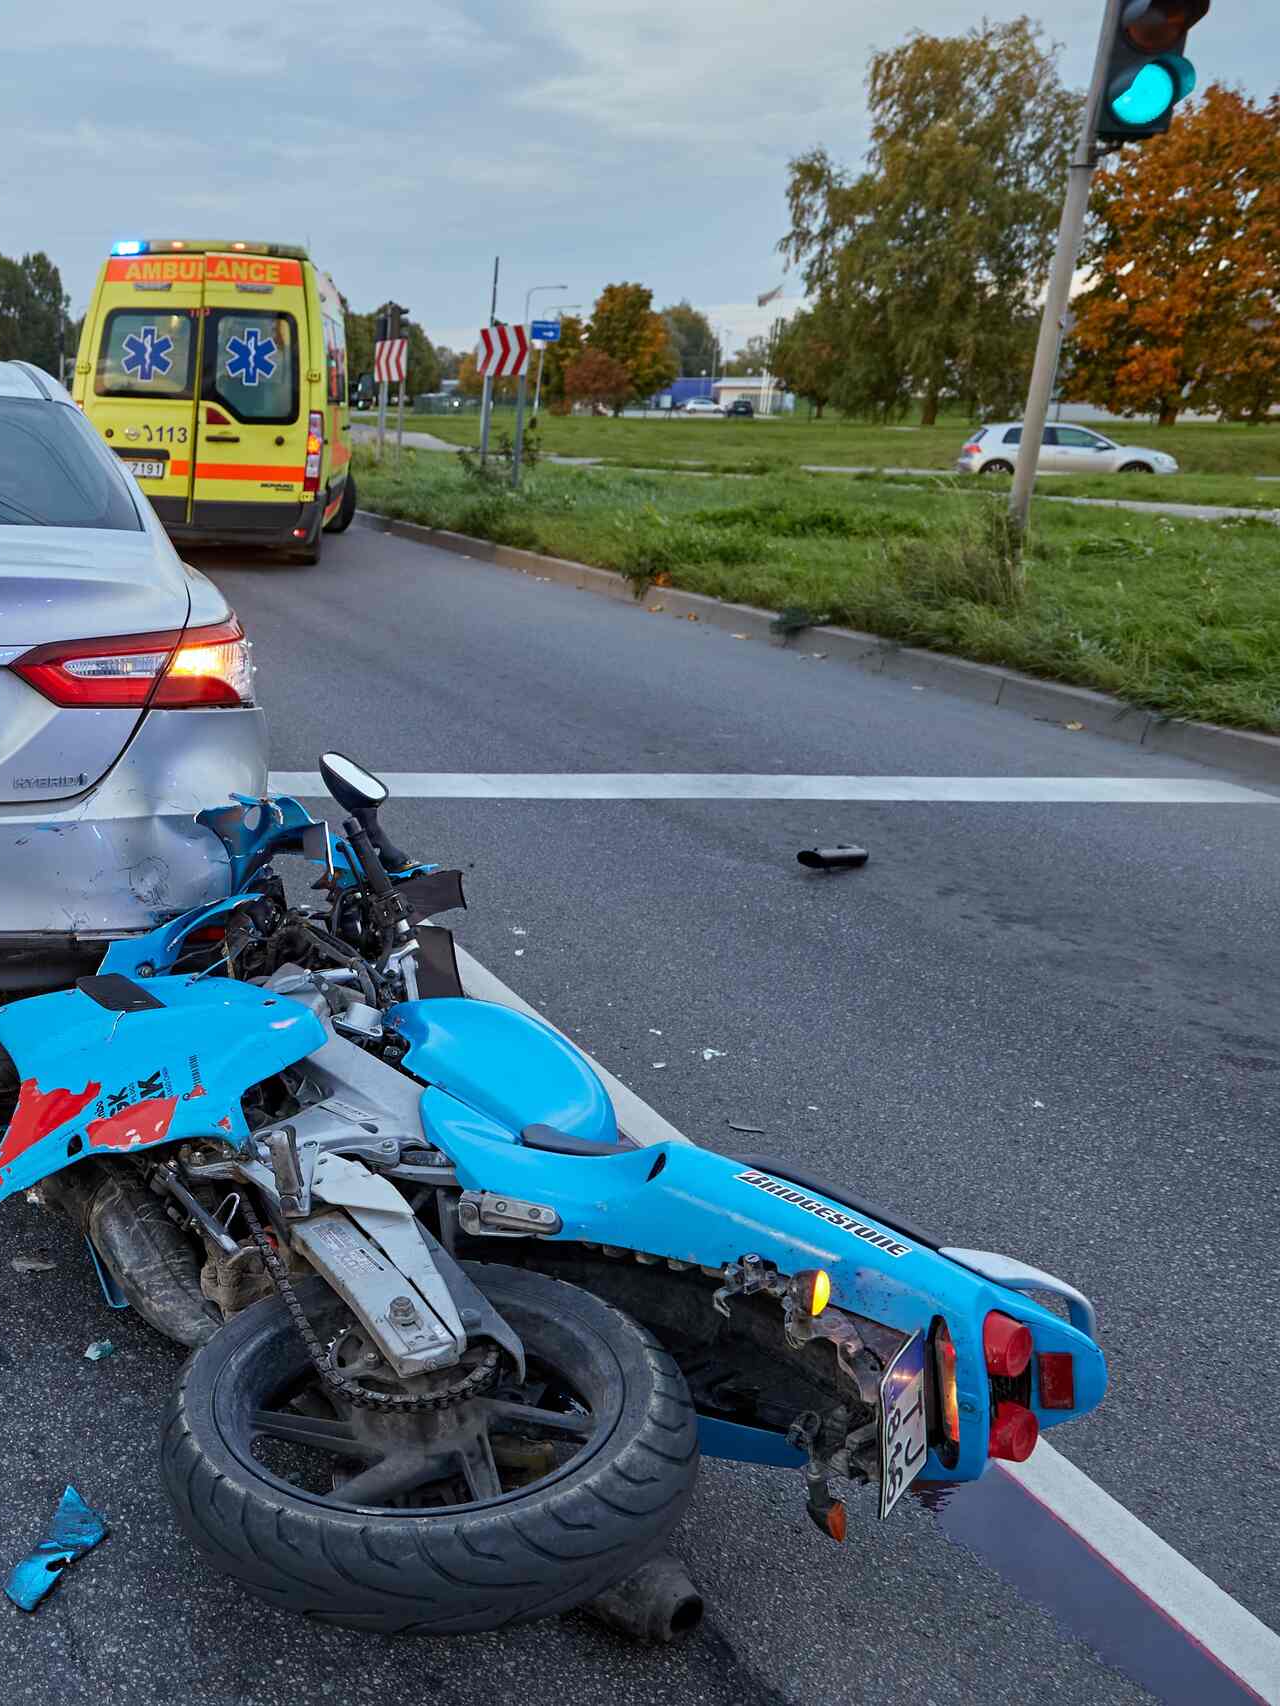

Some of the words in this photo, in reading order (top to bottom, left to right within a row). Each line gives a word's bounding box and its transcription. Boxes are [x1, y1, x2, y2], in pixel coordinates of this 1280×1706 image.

[125, 260, 280, 282] AMBULANCE
[156, 425, 187, 443] 113
[736, 1171, 910, 1256] BRIDGESTONE
